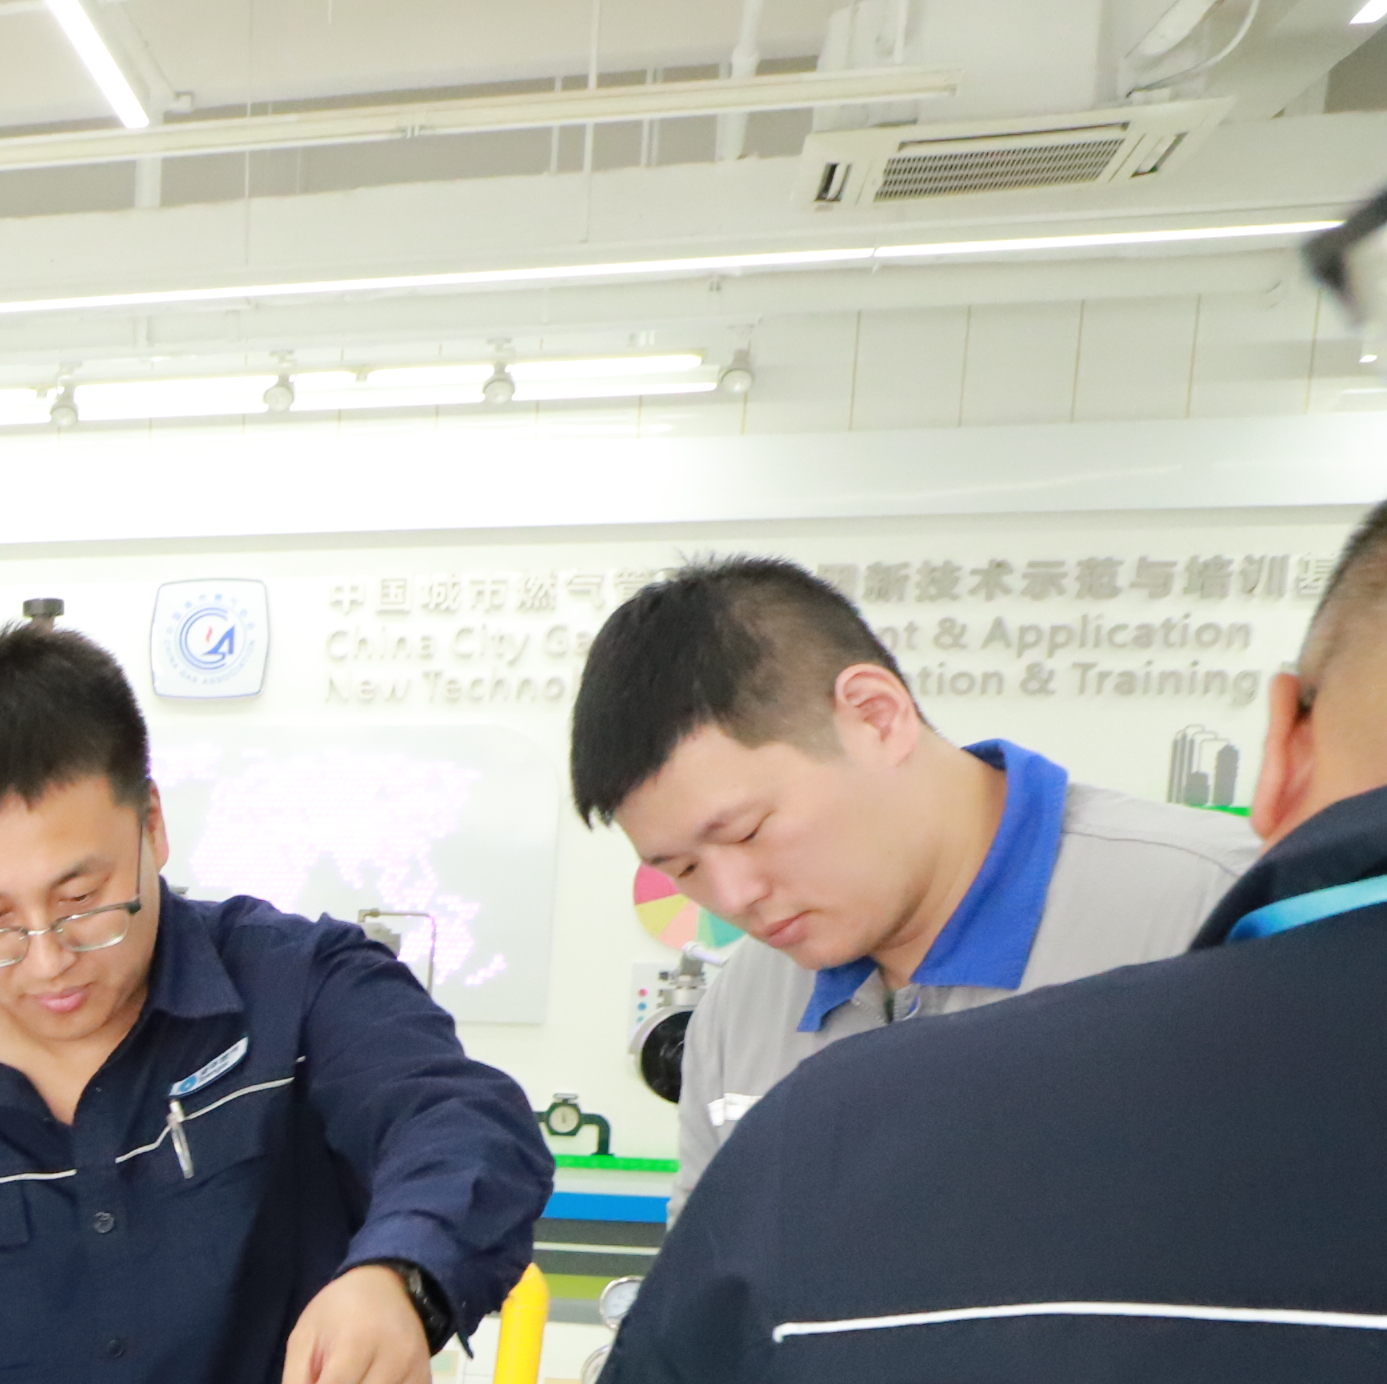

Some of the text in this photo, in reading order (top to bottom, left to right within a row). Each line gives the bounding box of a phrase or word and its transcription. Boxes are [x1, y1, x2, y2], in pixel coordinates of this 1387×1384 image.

[325, 626, 435, 661] China
[453, 624, 531, 666] City
[542, 623, 595, 660] Ga
[933, 616, 967, 651] &
[980, 612, 1251, 657] Application
[325, 673, 410, 704] New
[422, 667, 581, 703] Technol
[1019, 662, 1057, 697] &
[1072, 660, 1261, 702] Training
